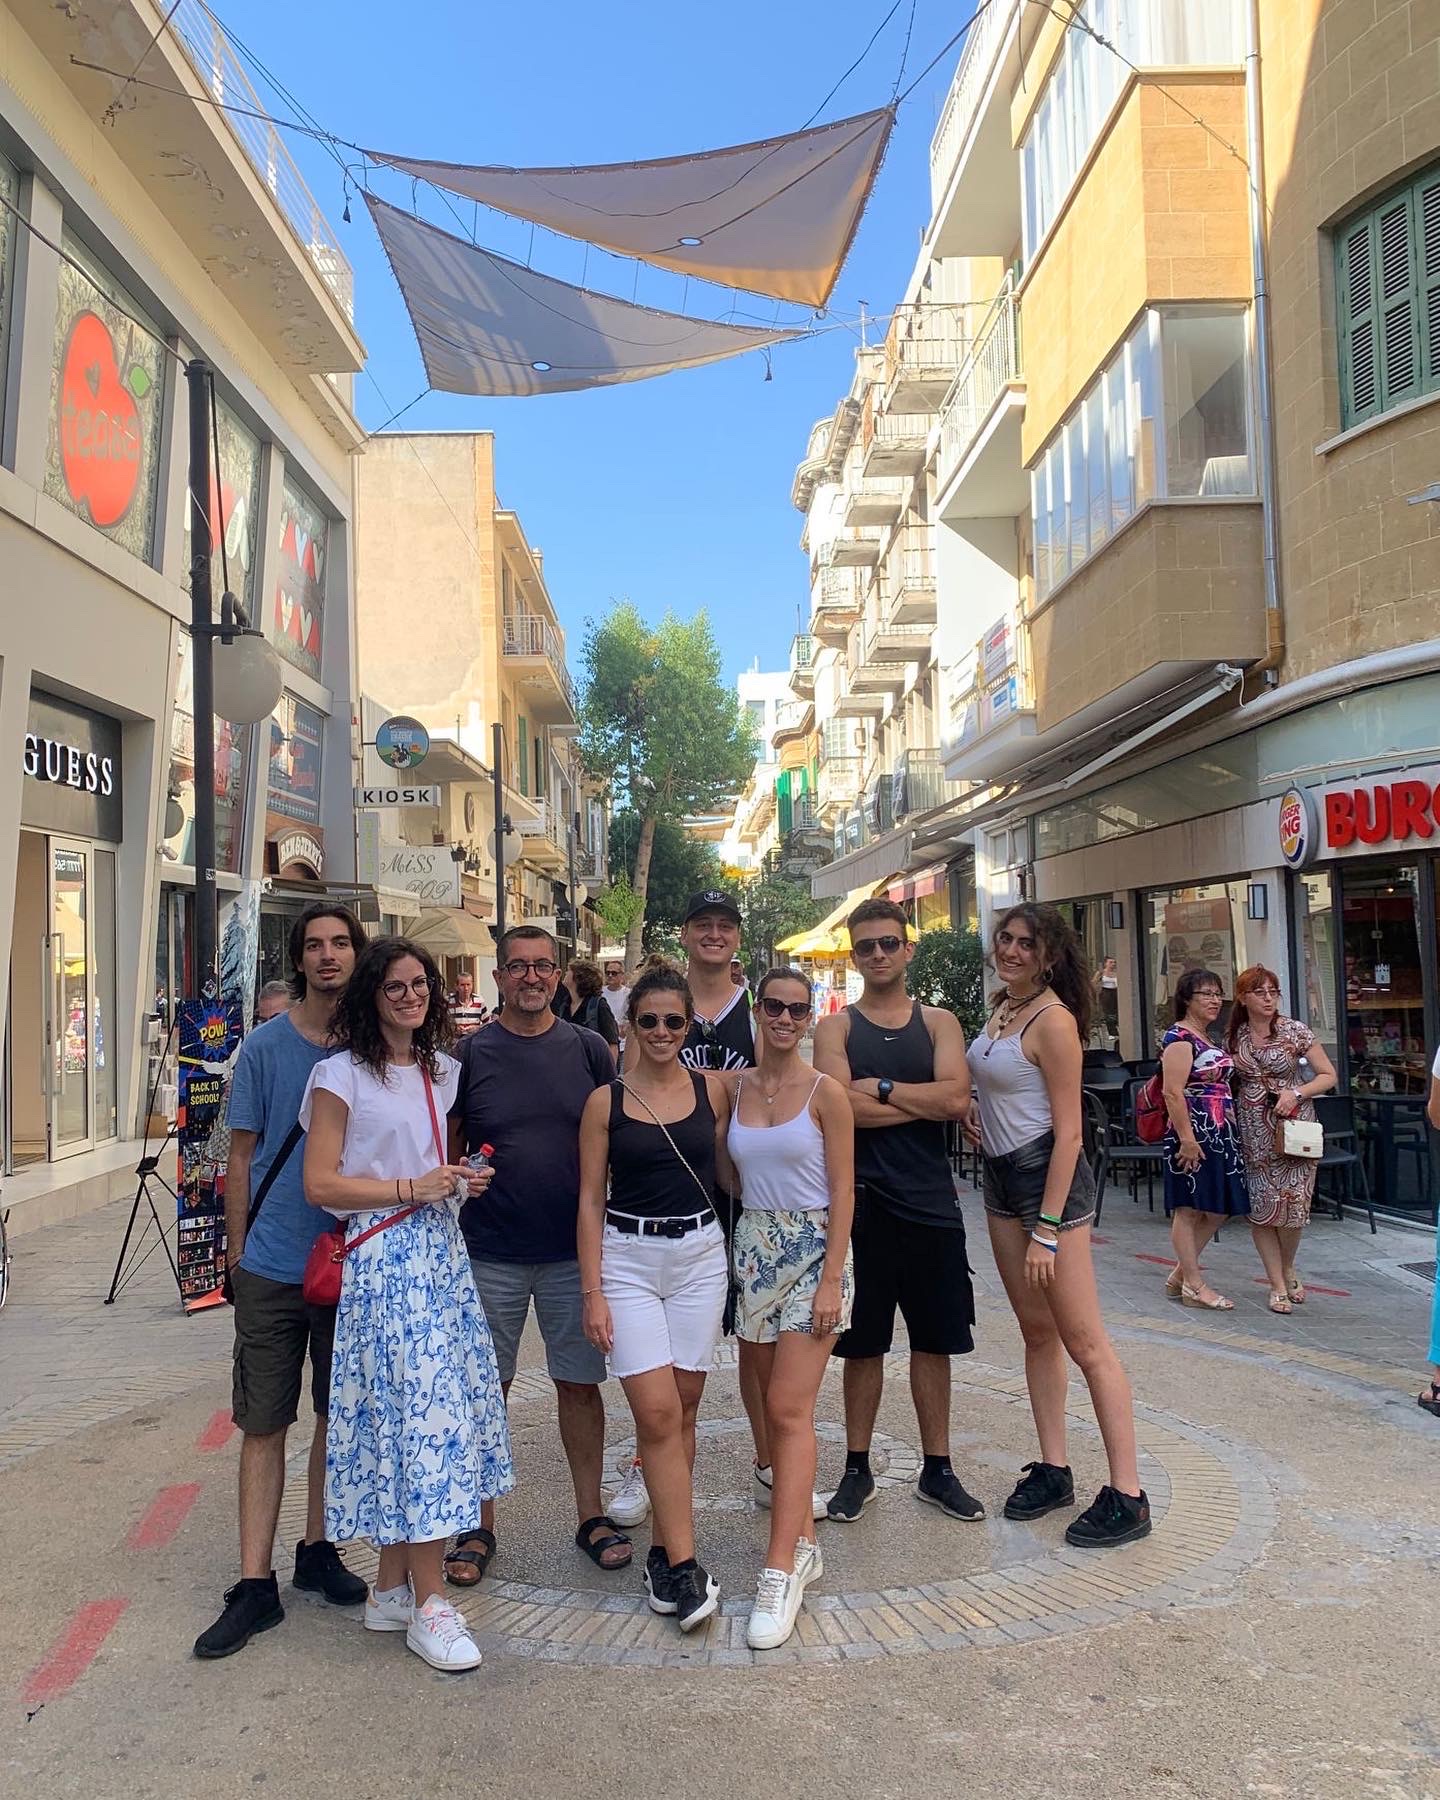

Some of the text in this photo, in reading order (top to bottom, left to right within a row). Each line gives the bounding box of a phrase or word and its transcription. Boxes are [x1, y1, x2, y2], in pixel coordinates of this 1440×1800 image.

[24, 733, 113, 796] GUESS
[363, 789, 430, 803] KIOSK
[1325, 780, 1440, 848] BUR
[199, 1020, 228, 1041] POW!
[190, 1080, 219, 1093] BACK TO
